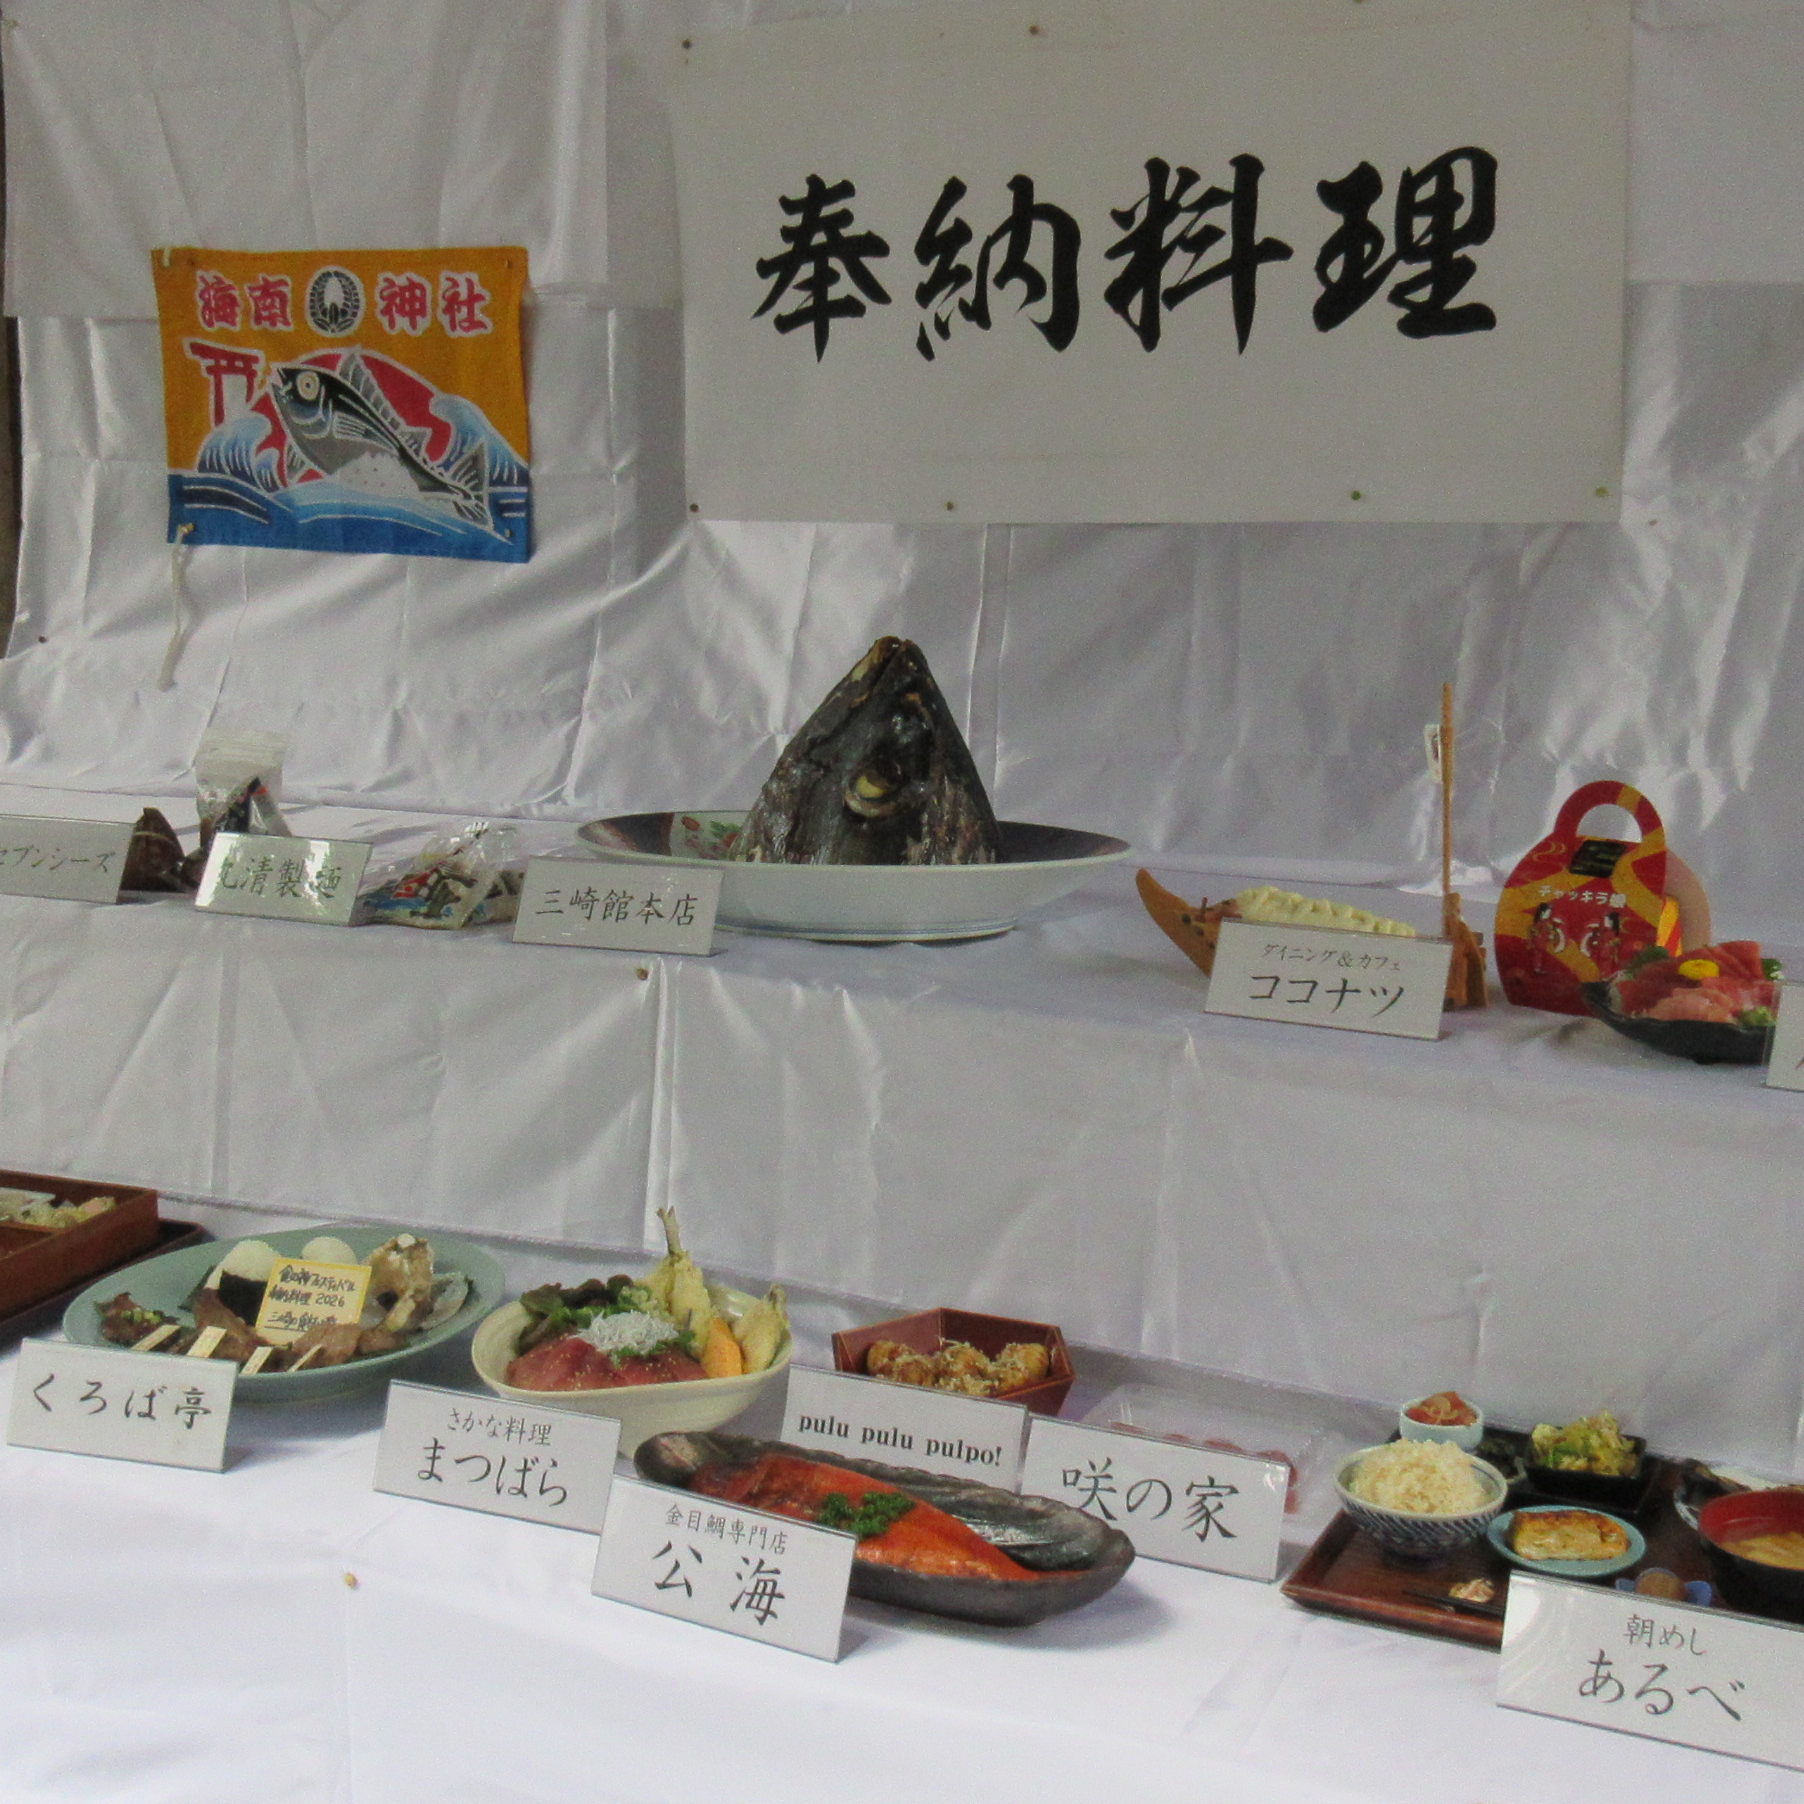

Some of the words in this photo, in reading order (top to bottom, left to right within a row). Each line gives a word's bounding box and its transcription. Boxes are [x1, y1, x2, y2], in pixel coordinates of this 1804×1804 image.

[751, 145, 1498, 363] 奉納料理
[198, 273, 292, 329] 海南
[379, 275, 490, 333] 神社
[535, 888, 699, 928] 三崎館本店
[1249, 975, 1404, 1018] ココナツ
[315, 1292, 345, 1308] 2026
[32, 1373, 213, 1430] くろば亭
[447, 1407, 552, 1447] さかな料理
[799, 1414, 849, 1439] pulu
[861, 1426, 913, 1450] pulu
[925, 1437, 1002, 1467] pulpo!
[417, 1436, 568, 1508] まつばら
[1061, 1456, 1240, 1544] 咲の家
[664, 1502, 790, 1556] 金目鯛専門店
[652, 1539, 786, 1627] 公海
[1623, 1612, 1708, 1656] 朝めし
[1578, 1648, 1747, 1722] あるべ
